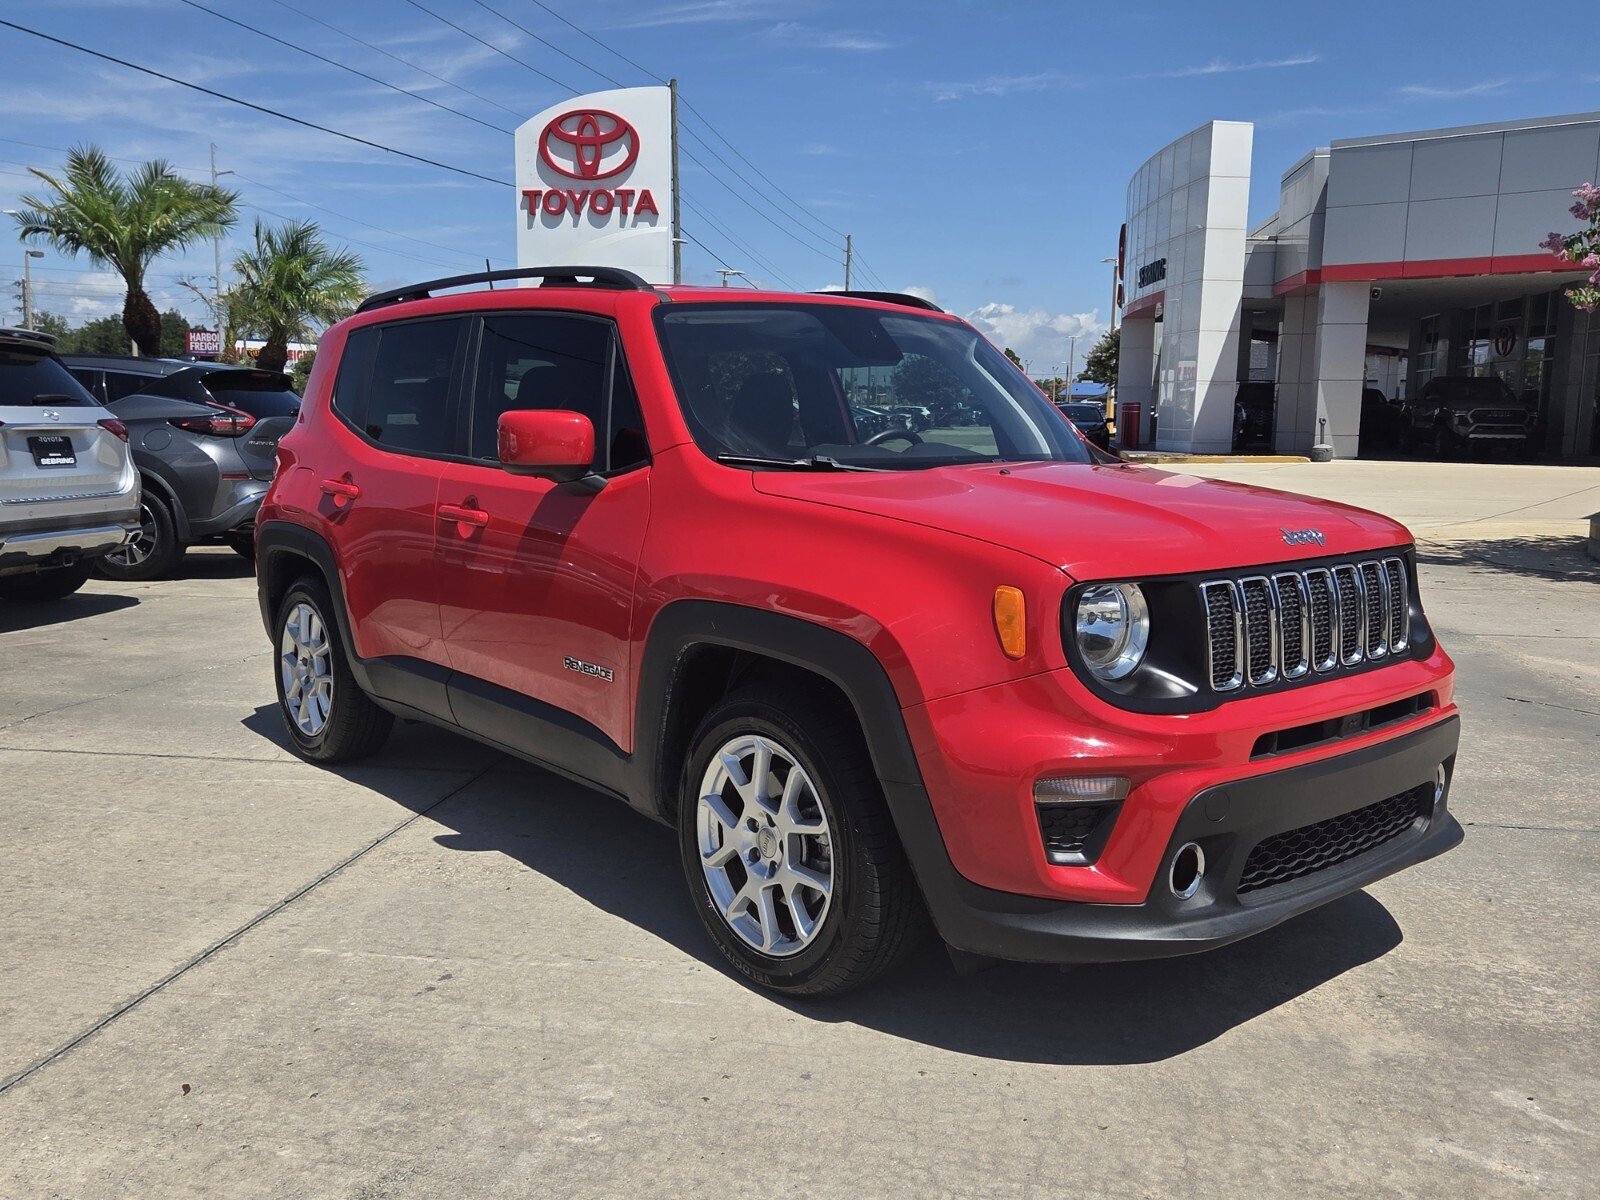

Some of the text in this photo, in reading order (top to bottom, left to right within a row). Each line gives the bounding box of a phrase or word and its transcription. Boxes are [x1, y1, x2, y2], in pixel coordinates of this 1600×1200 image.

[522, 189, 659, 215] TOYOTA
[189, 332, 220, 342] HARBO
[1280, 527, 1327, 547] Jeep
[563, 655, 614, 682] RENEGADE
